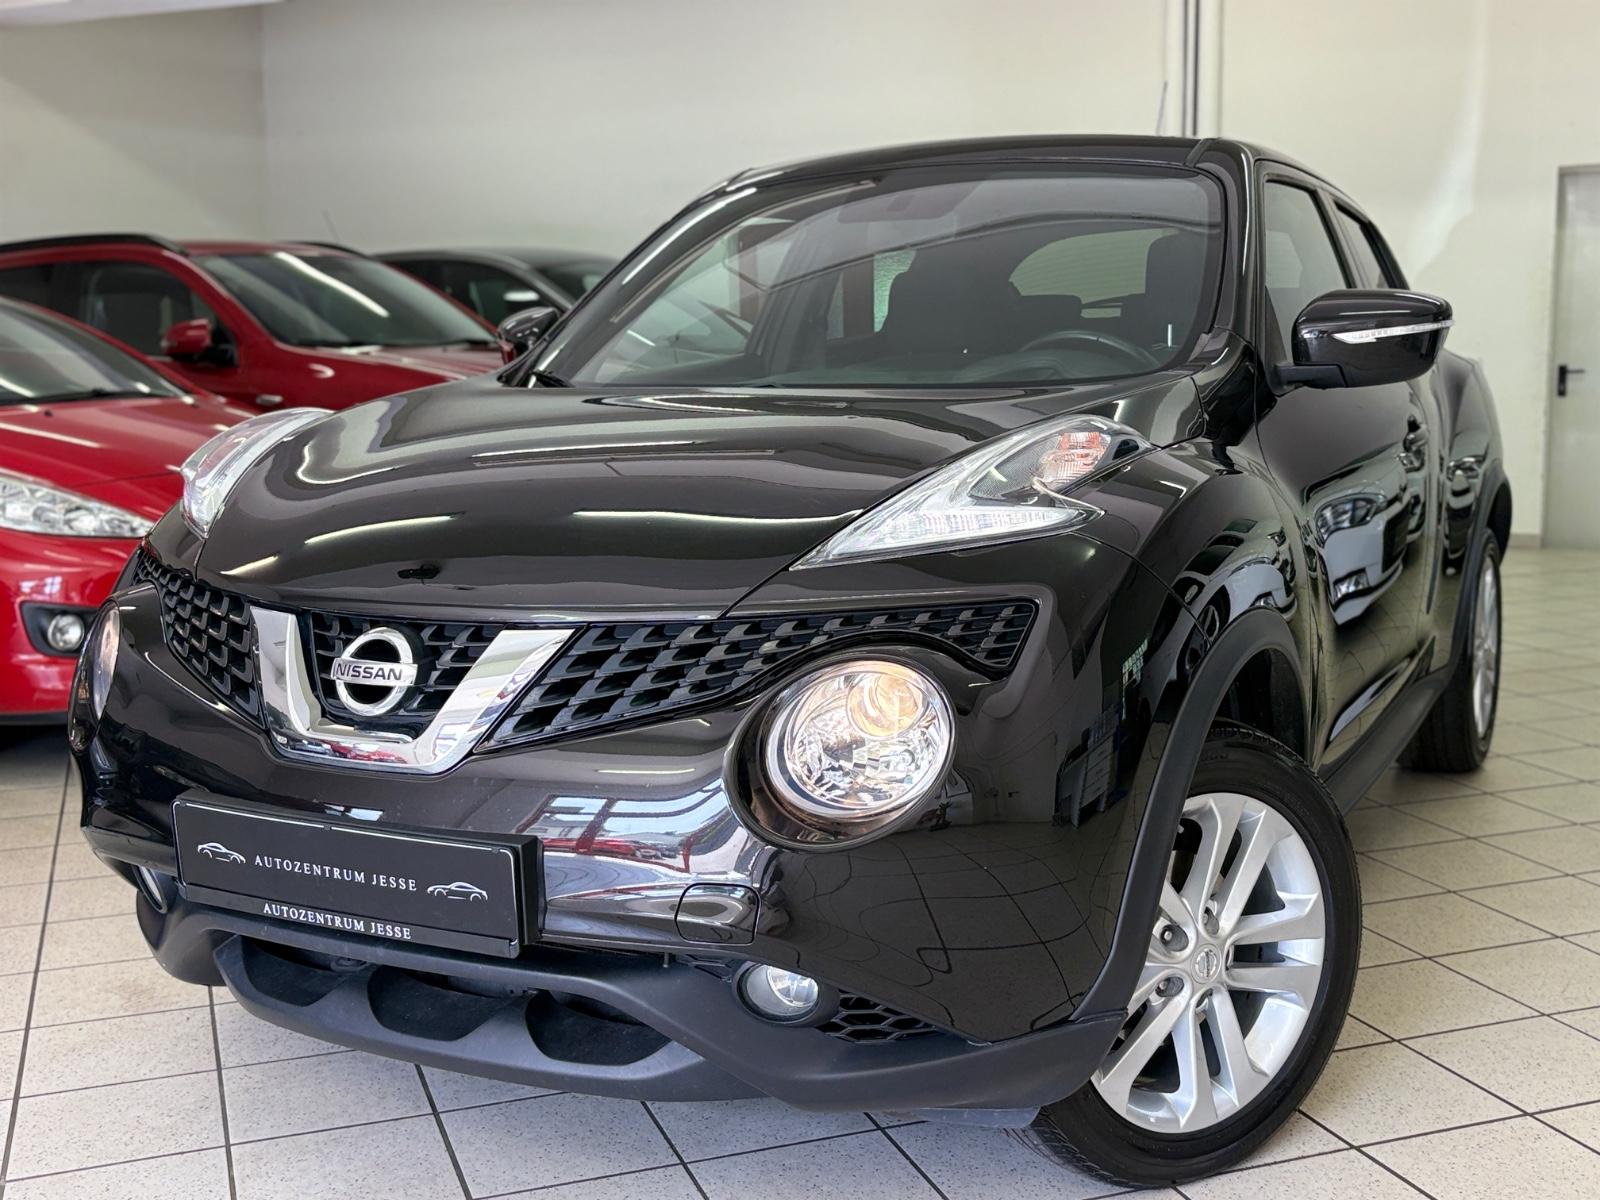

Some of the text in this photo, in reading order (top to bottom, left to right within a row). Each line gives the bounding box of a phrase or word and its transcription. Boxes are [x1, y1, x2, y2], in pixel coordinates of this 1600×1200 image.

[335, 663, 402, 681] NISSAN
[254, 855, 417, 891] AUTOZENTRUM JESSE
[263, 903, 412, 940] AUTOZENTRUM JESSE
